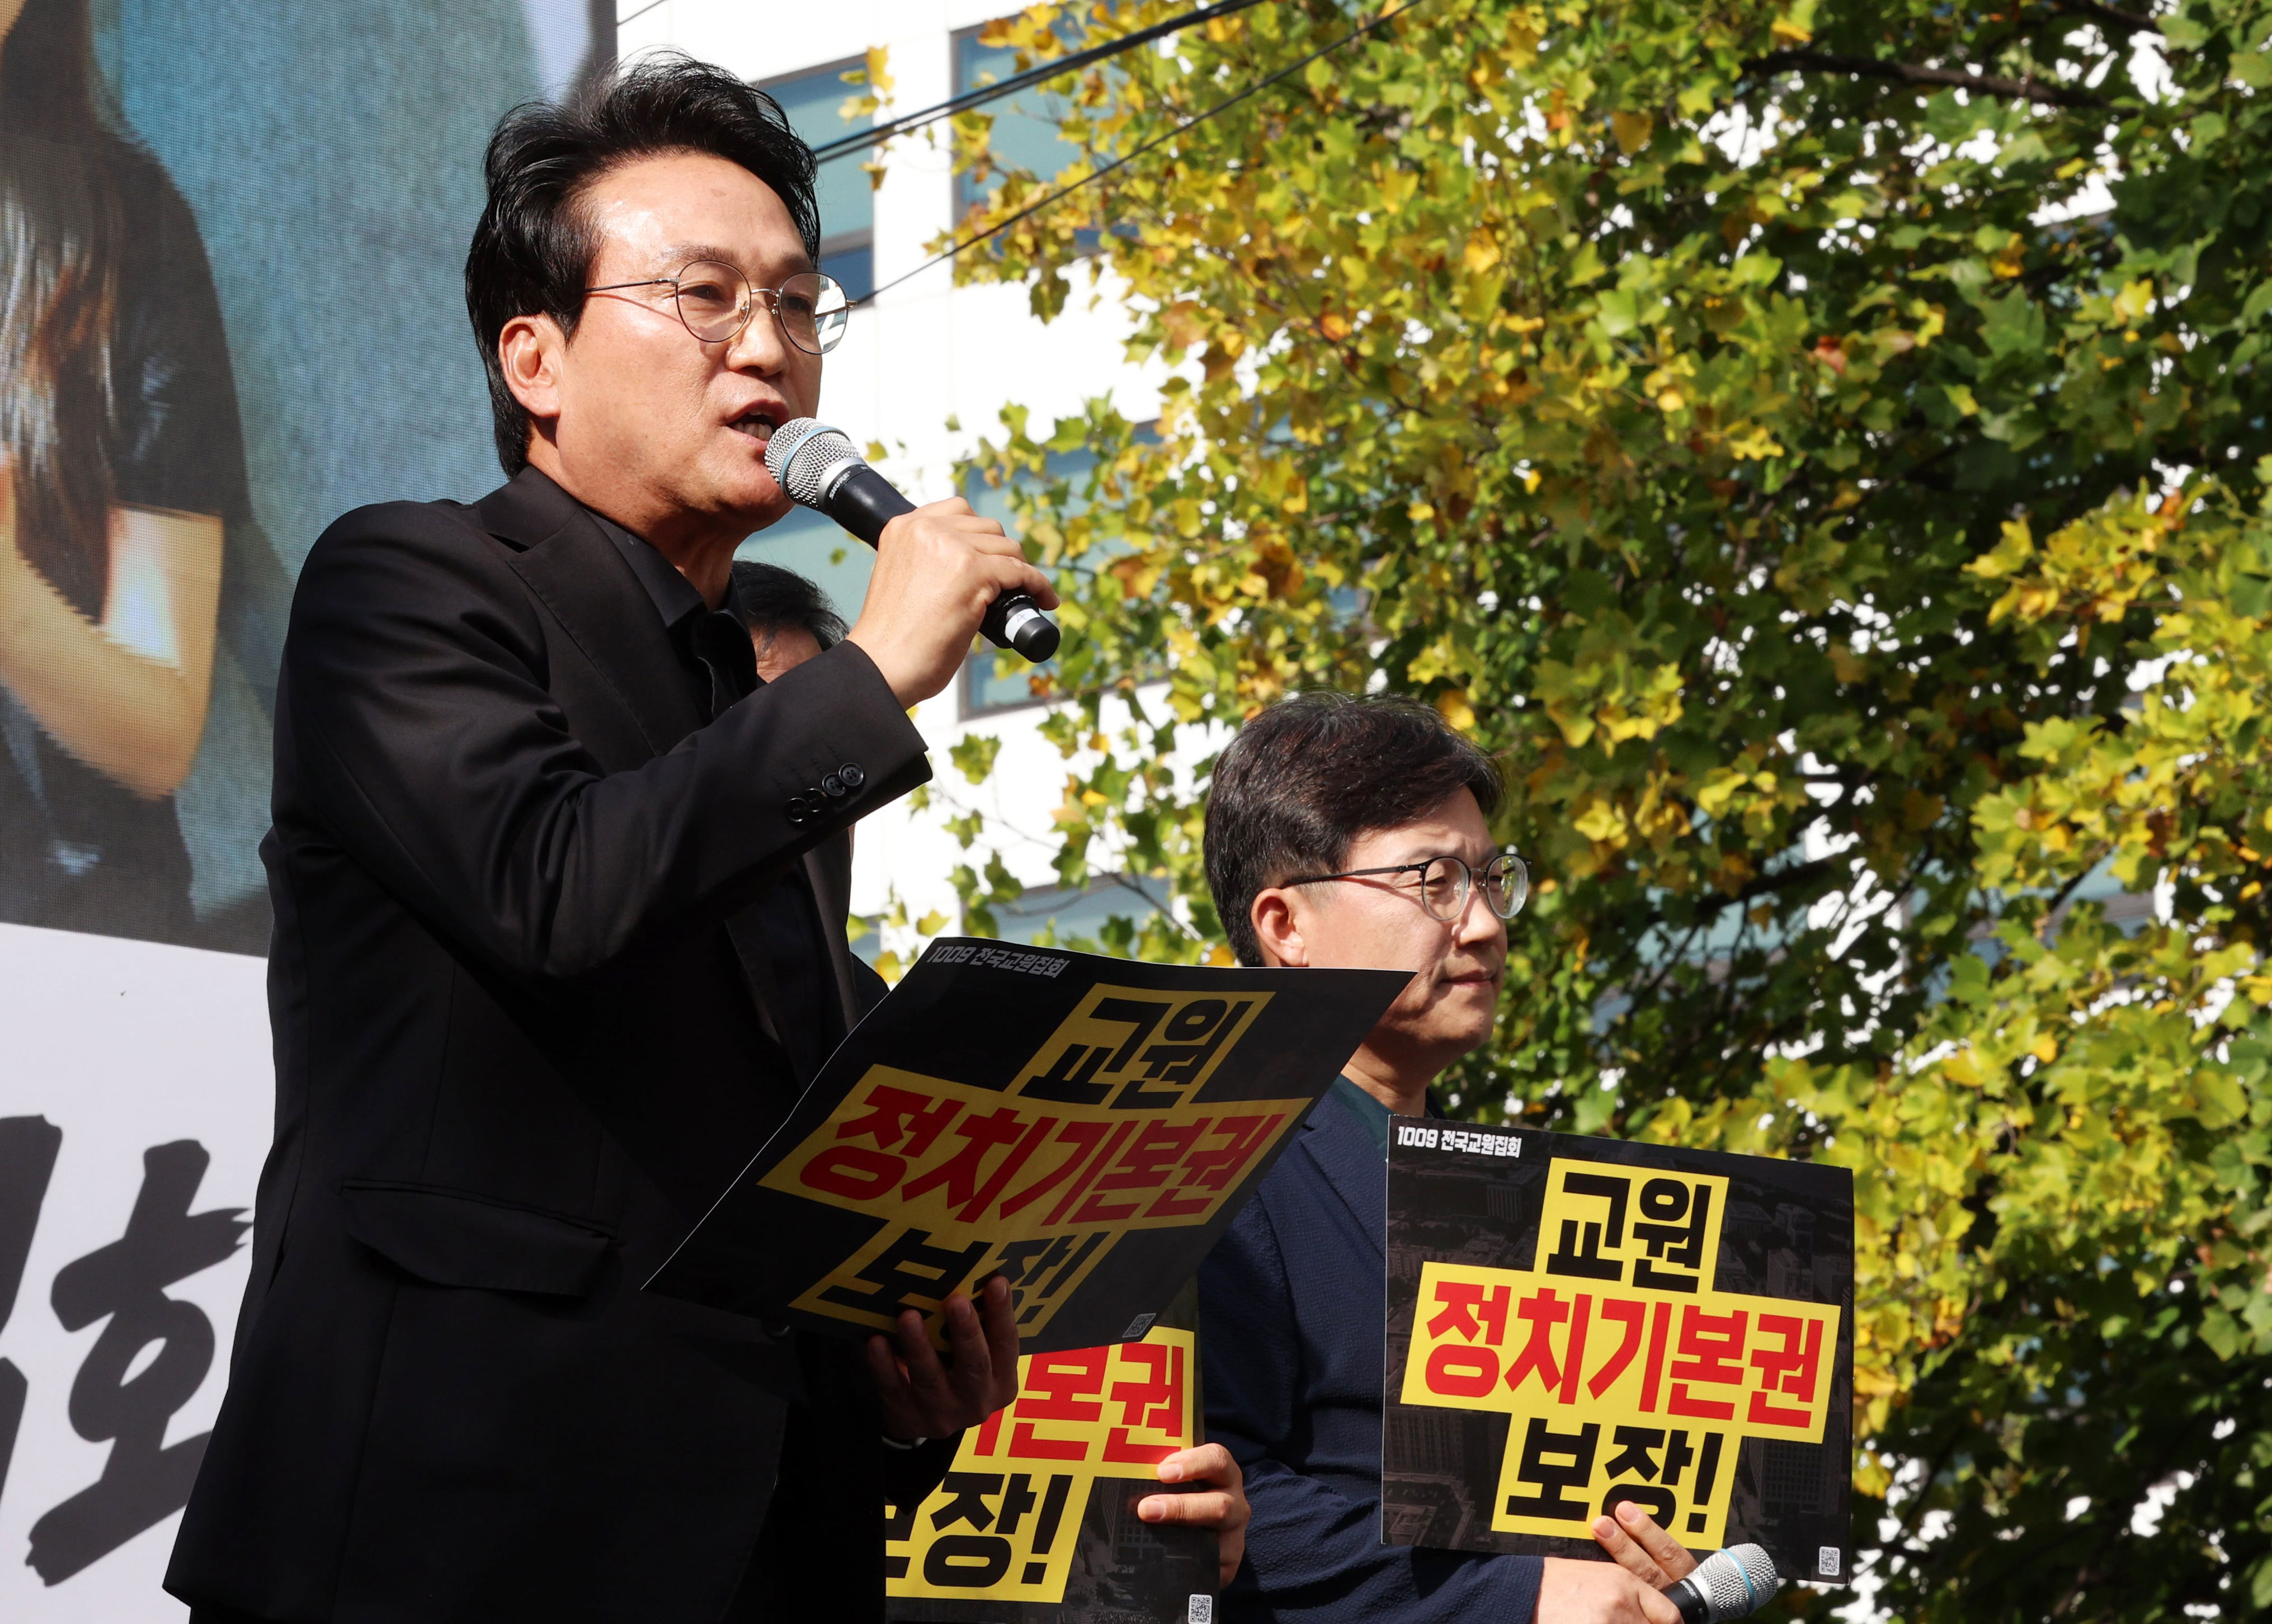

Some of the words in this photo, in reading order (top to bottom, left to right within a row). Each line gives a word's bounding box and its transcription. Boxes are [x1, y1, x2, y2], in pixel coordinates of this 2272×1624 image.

[829, 471, 850, 500] SHURE
[926, 946, 977, 963] 1009
[969, 947, 1071, 978] 전국교원집회
[1016, 998, 1255, 1110] 교원
[799, 1084, 1286, 1226] 정치기본권
[1397, 1126, 1439, 1148] 1009
[1440, 1129, 1522, 1158] 전국교원집회
[1546, 1171, 1712, 1293] 교원
[973, 1342, 1184, 1464] 본권
[1425, 1281, 1824, 1429] 정치기본권
[1505, 1417, 1724, 1533] 보장!
